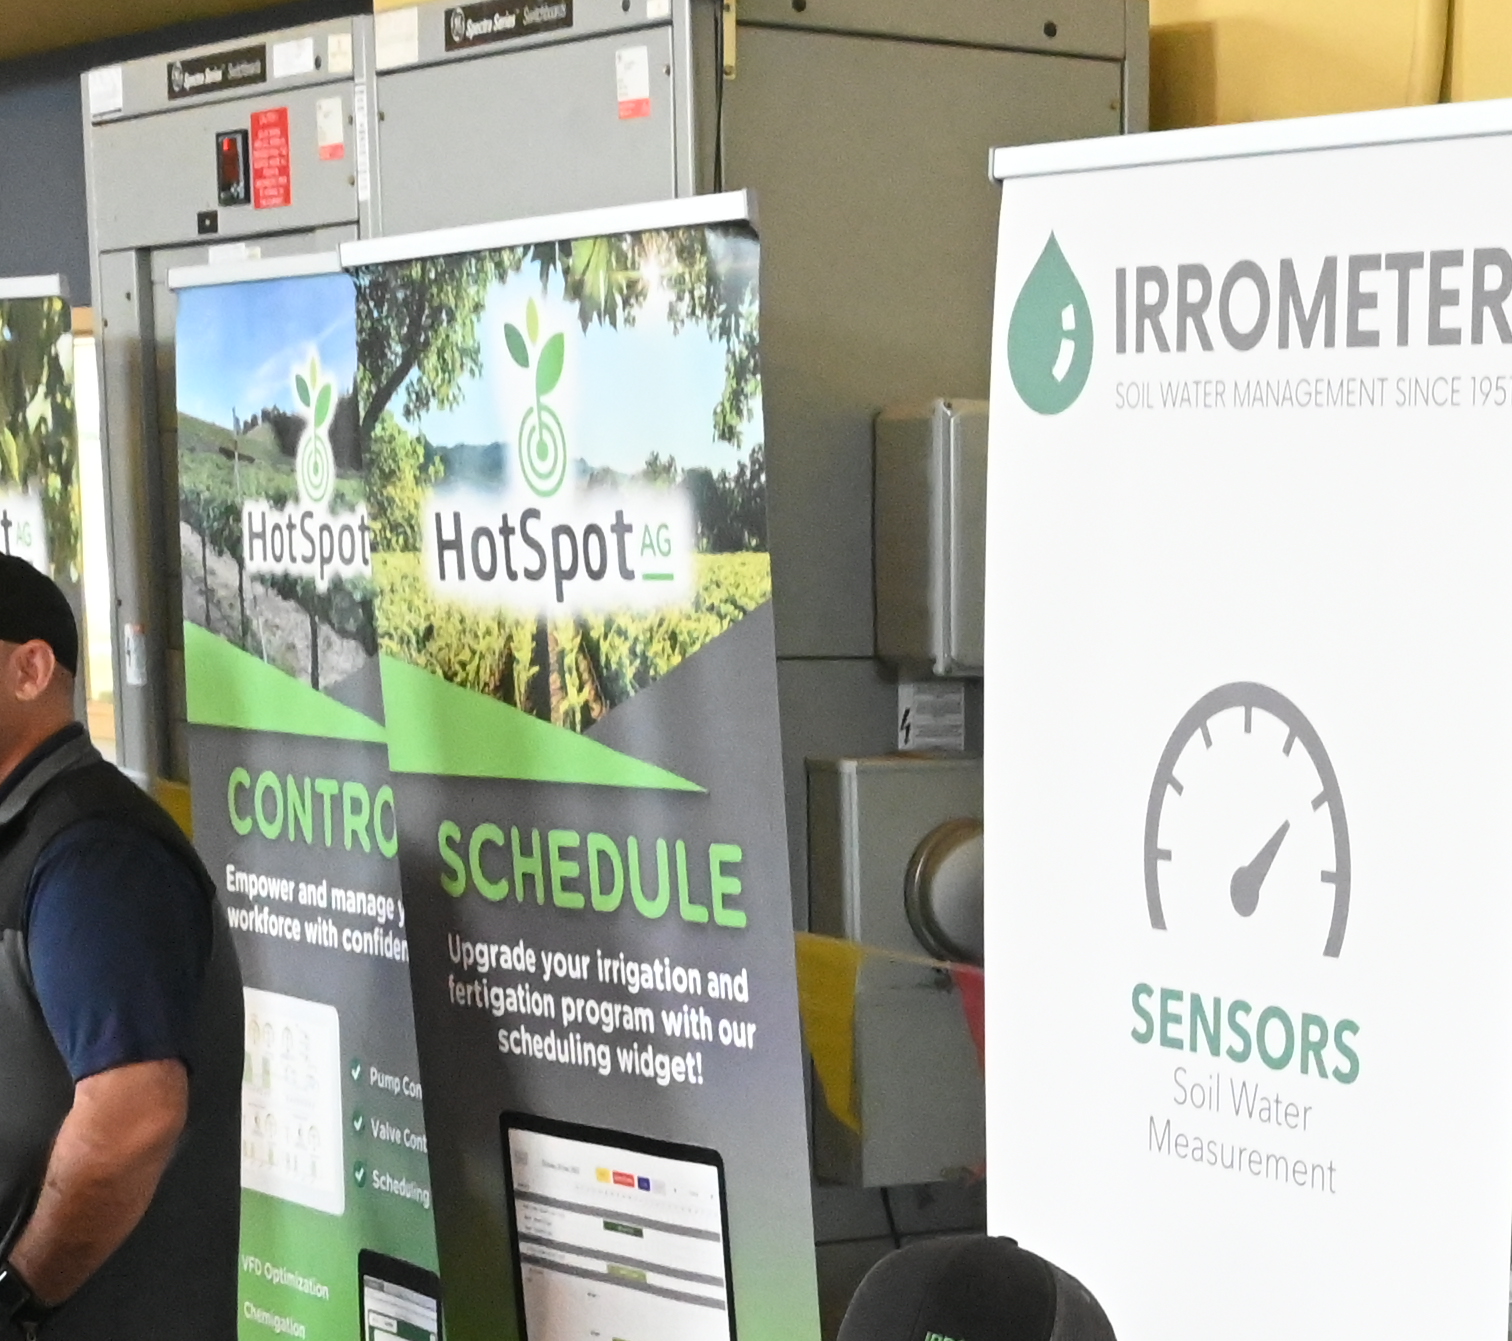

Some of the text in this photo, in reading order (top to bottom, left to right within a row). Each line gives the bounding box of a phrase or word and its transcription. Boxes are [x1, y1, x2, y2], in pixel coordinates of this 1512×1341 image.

[1115, 381, 1153, 409] SOIL
[1159, 379, 1226, 409] WATER
[1233, 377, 1388, 407] MANAGEMENT
[1395, 376, 1461, 407] SINCE
[247, 510, 370, 580] HotSpot
[435, 508, 671, 603] HotSpot AG
[226, 863, 294, 902] Empower
[298, 878, 328, 909] and
[331, 887, 395, 924] manage
[438, 820, 747, 928] SCHEDULE
[228, 905, 301, 941] workforce
[305, 916, 338, 948] with
[448, 933, 748, 1003] Upgrade your irrigation and
[448, 974, 756, 1050] fertigation program with our
[1130, 982, 1361, 1085] SENSORS
[370, 1066, 400, 1096] Pump
[498, 1025, 703, 1087] scheduling widget!
[1172, 1065, 1312, 1133] Soil Water
[371, 1117, 401, 1144] Valve
[1148, 1115, 1337, 1194] Measurement
[372, 1169, 430, 1209] Scheduling
[241, 1254, 329, 1300] VFD Optimization
[244, 1301, 306, 1340] Chemigation
